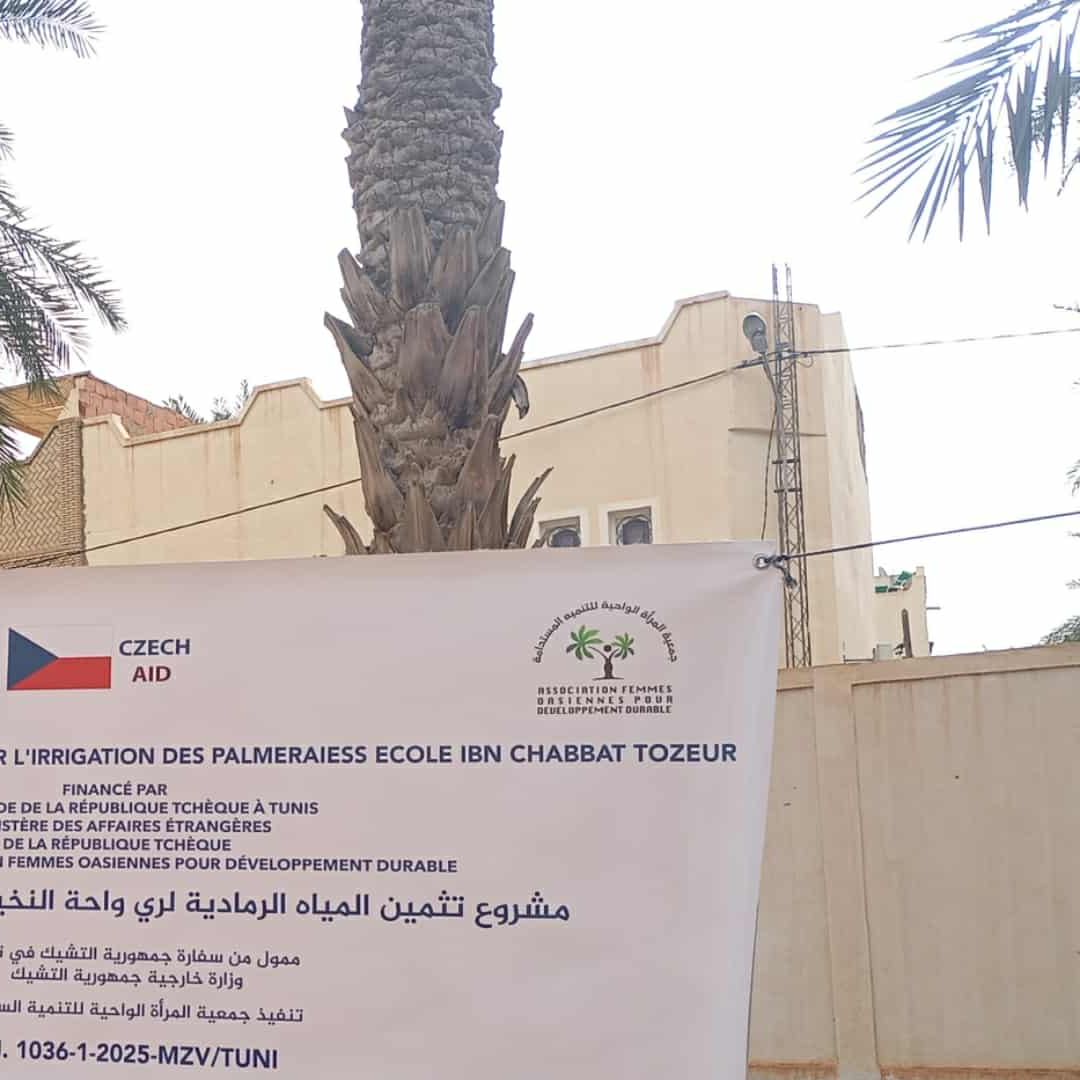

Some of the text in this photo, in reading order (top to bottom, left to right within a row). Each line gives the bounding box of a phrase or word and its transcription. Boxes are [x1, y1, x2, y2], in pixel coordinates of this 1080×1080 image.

[119, 637, 190, 657] CZECH
[132, 665, 171, 683] AID
[537, 684, 673, 696] ASSOCIATION FEMMES
[537, 695, 674, 706] OASIENNES POUR
[625, 705, 672, 715] DURABLE
[13, 747, 155, 766] L'IRRIGATION
[162, 746, 204, 765] DES
[211, 745, 367, 765] PALMERAIESS
[375, 745, 453, 764] ECOLE
[461, 745, 502, 764] IBN
[509, 744, 627, 764] CHABBAT
[633, 743, 737, 763] TOZEUR
[62, 781, 168, 797] FINANCÉ PAR
[21, 801, 42, 815] DE
[46, 801, 66, 815] LA
[69, 798, 169, 815] RÉPUBLIQUE
[172, 798, 250, 816] TCHÈQUE
[253, 798, 266, 815] À
[269, 801, 319, 816] TUNIS
[52, 819, 84, 833] DES
[86, 819, 161, 833] AFFAIRES
[165, 816, 272, 834] ÉTRANGÈRES
[3, 834, 232, 852] DE LA RÉPUBLIQUE TCHÈQUE
[7, 855, 75, 869] FEMMES
[77, 855, 171, 870] OASIENNES
[174, 856, 221, 871] POUR
[225, 854, 374, 873] DÉVELOPPEMENT
[377, 858, 459, 874] DURABLE
[64, 889, 125, 919] واحة
[132, 890, 176, 923] لري
[185, 890, 287, 921] الرمادية
[295, 892, 370, 923] المياه
[379, 889, 465, 924] تثمين
[474, 890, 571, 928] مشروع
[8, 945, 36, 965] في
[39, 944, 98, 962] التشيك
[103, 947, 173, 966] جمهورية
[176, 949, 224, 965] سفارة
[228, 951, 252, 967] من
[256, 950, 301, 968] ممول
[10, 963, 244, 990] وزارة خارجية جمهورية التشيك
[27, 1000, 85, 1019] للتنمية
[89, 1001, 146, 1022] الواحية
[149, 998, 191, 1022] المرأة
[196, 1004, 252, 1024] جمعية
[255, 1006, 304, 1026] تنفيذ
[16, 1039, 278, 1070] 1036-1-2025-MZV/TUNI
